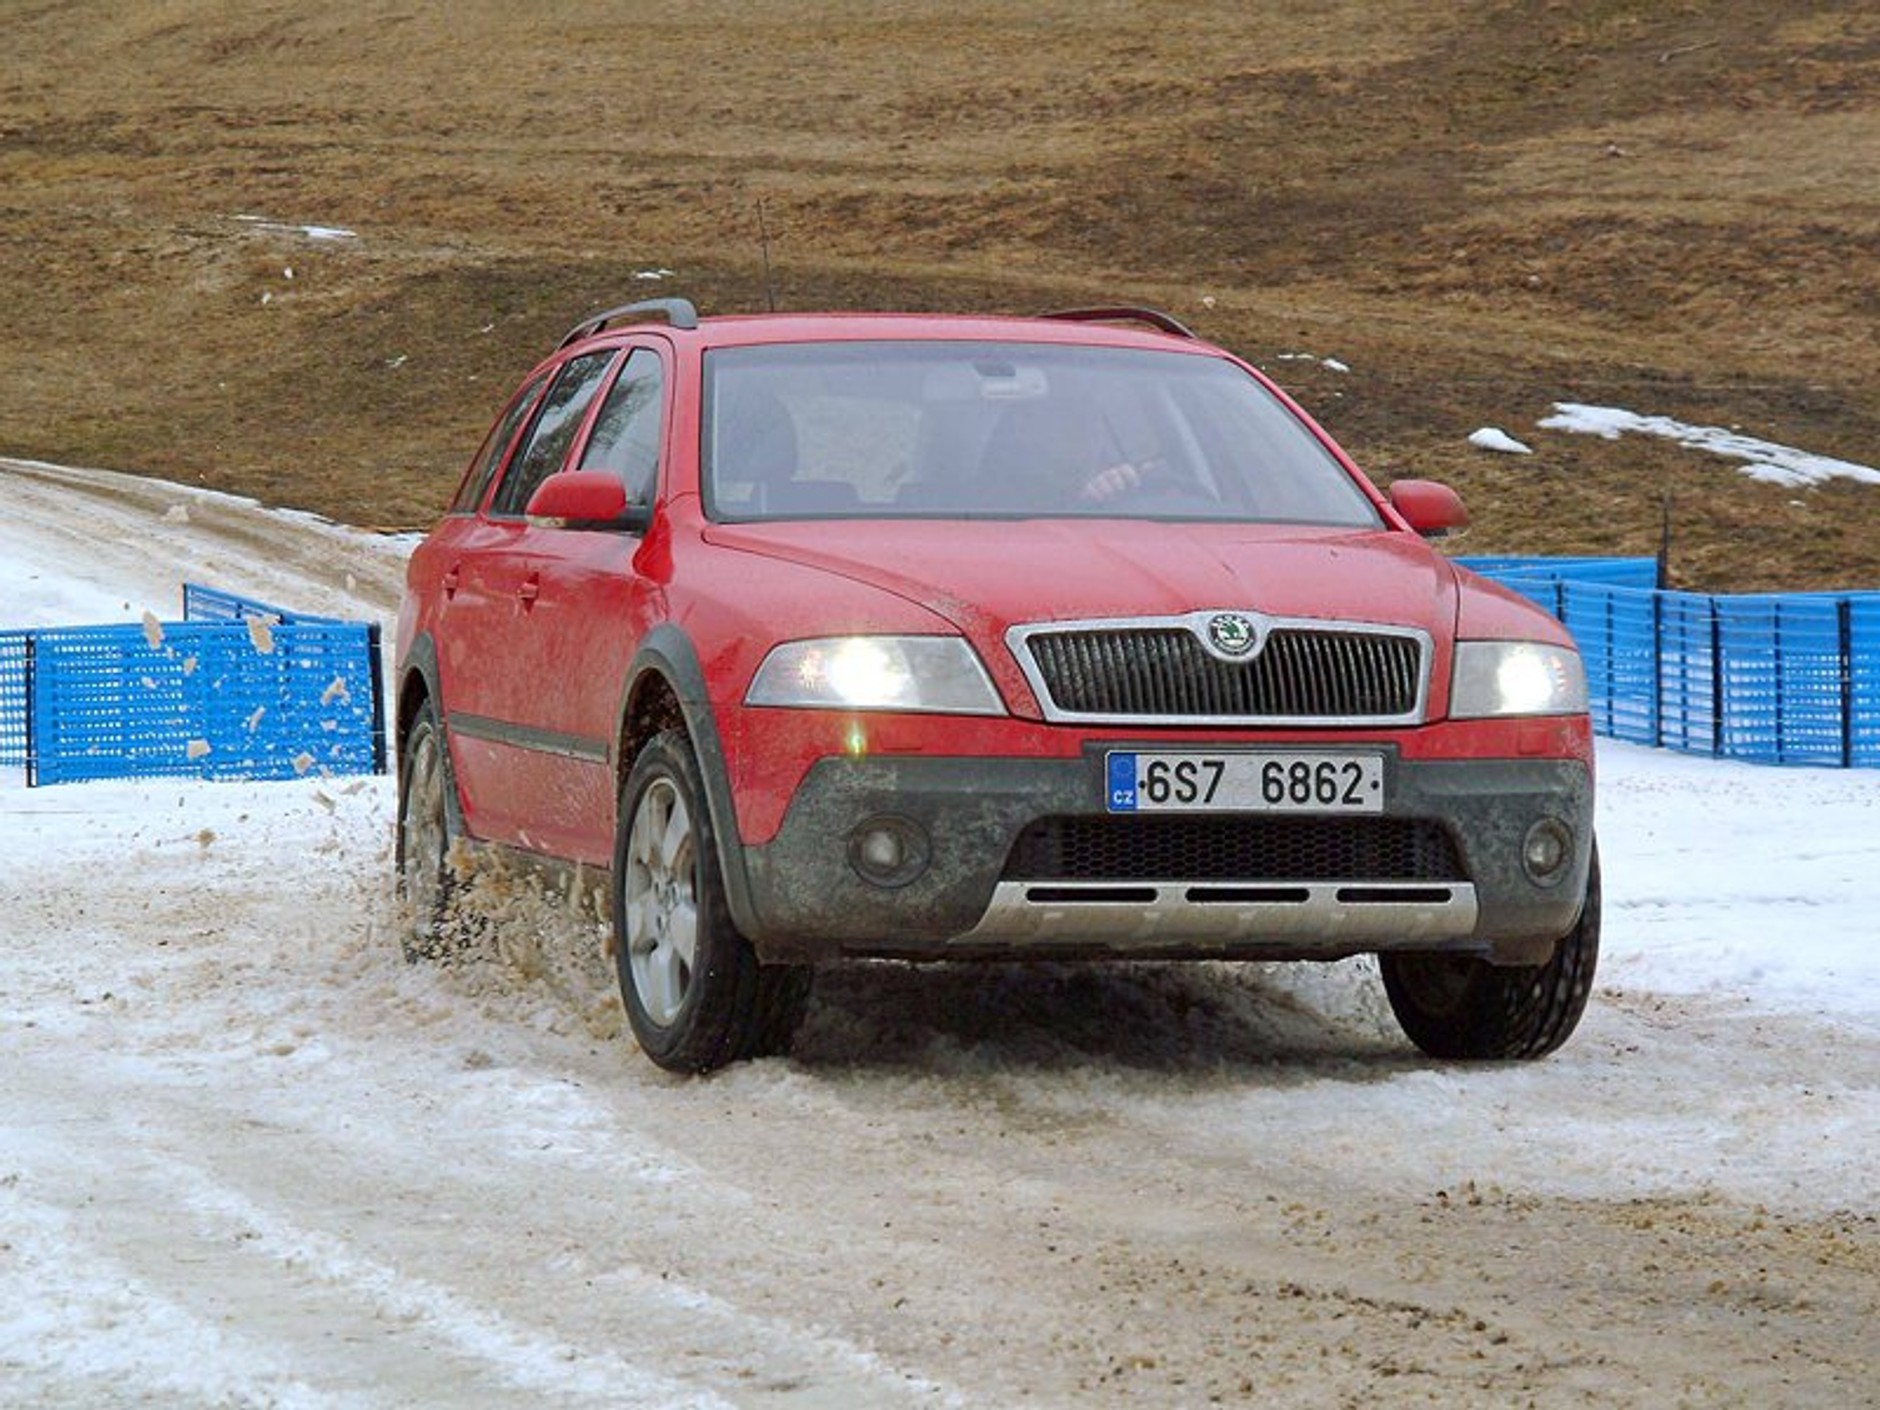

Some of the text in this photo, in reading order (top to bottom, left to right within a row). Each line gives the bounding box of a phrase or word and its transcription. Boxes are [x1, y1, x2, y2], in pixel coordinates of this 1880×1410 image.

[1113, 790, 1134, 805] CZ
[1147, 760, 1364, 805] 6S7 6862
